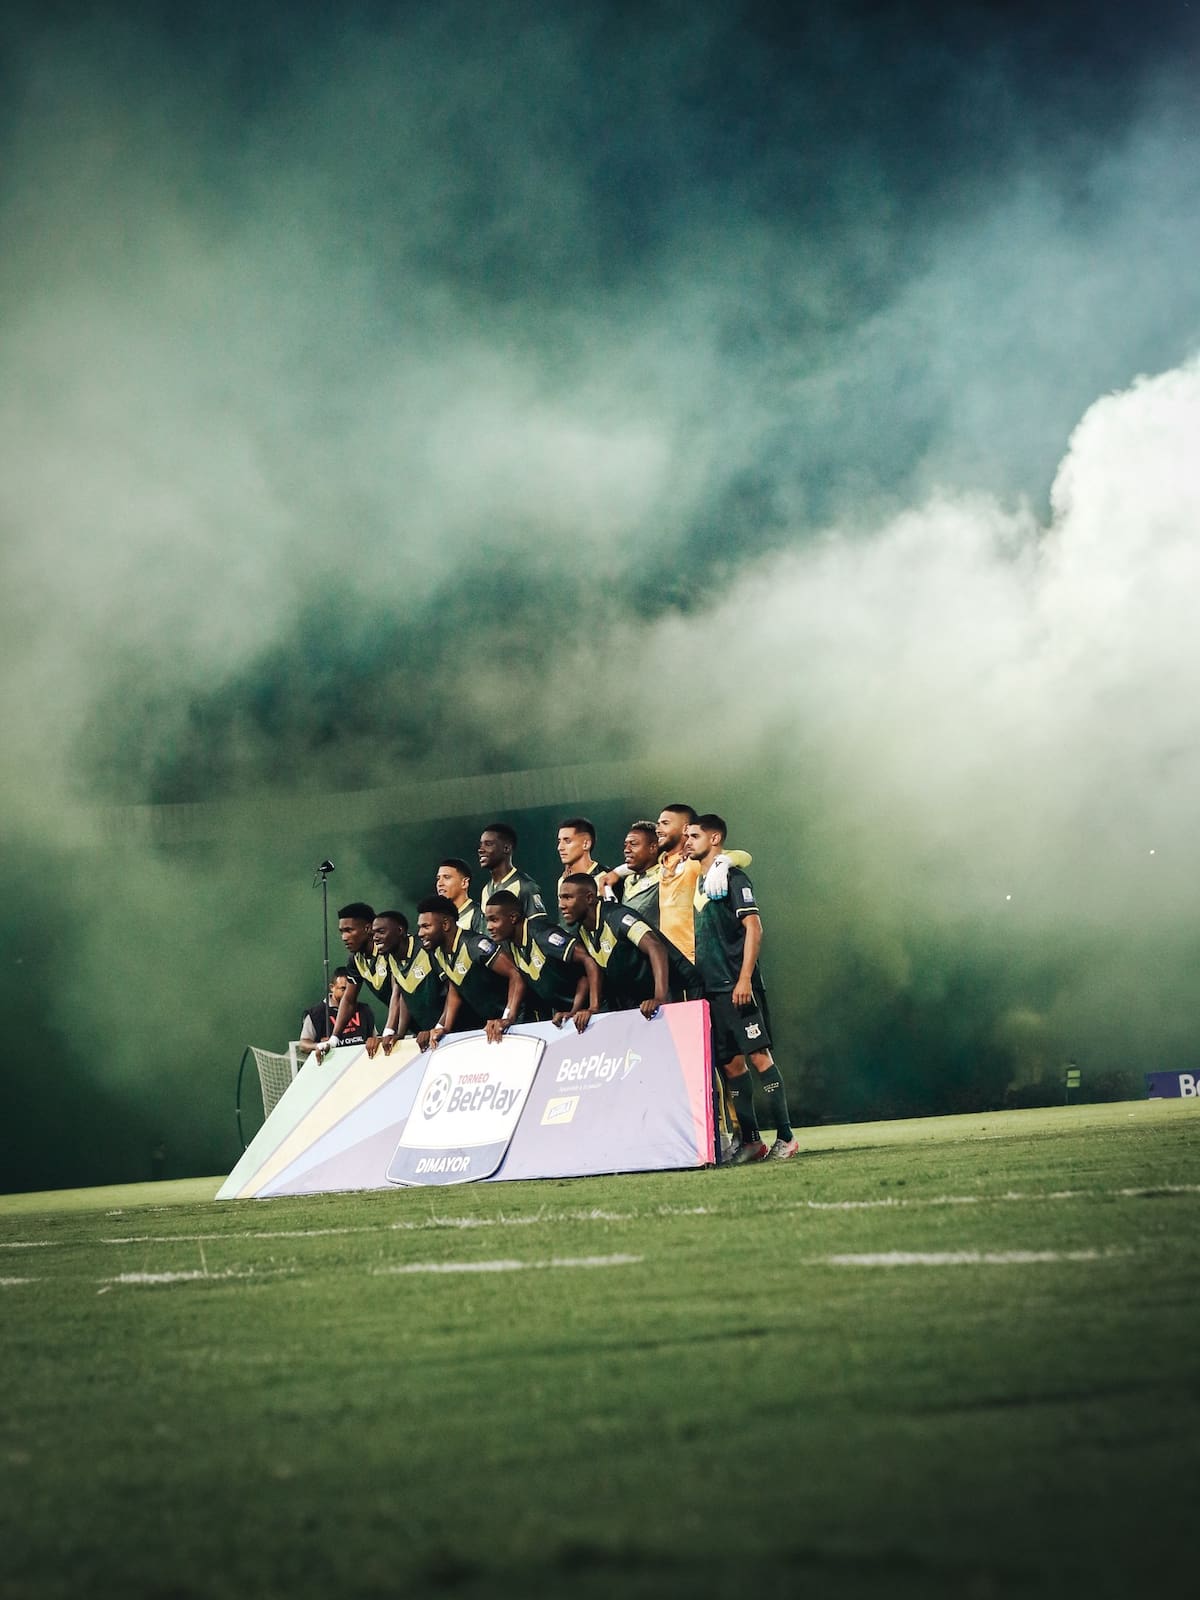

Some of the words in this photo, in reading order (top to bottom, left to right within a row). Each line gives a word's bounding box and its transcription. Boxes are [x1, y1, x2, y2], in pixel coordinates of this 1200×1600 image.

[458, 1073, 490, 1085] TORNEO
[555, 1052, 623, 1082] BetPlay
[446, 1081, 521, 1116] BetPlay
[415, 1156, 471, 1174] DIMAYOR
